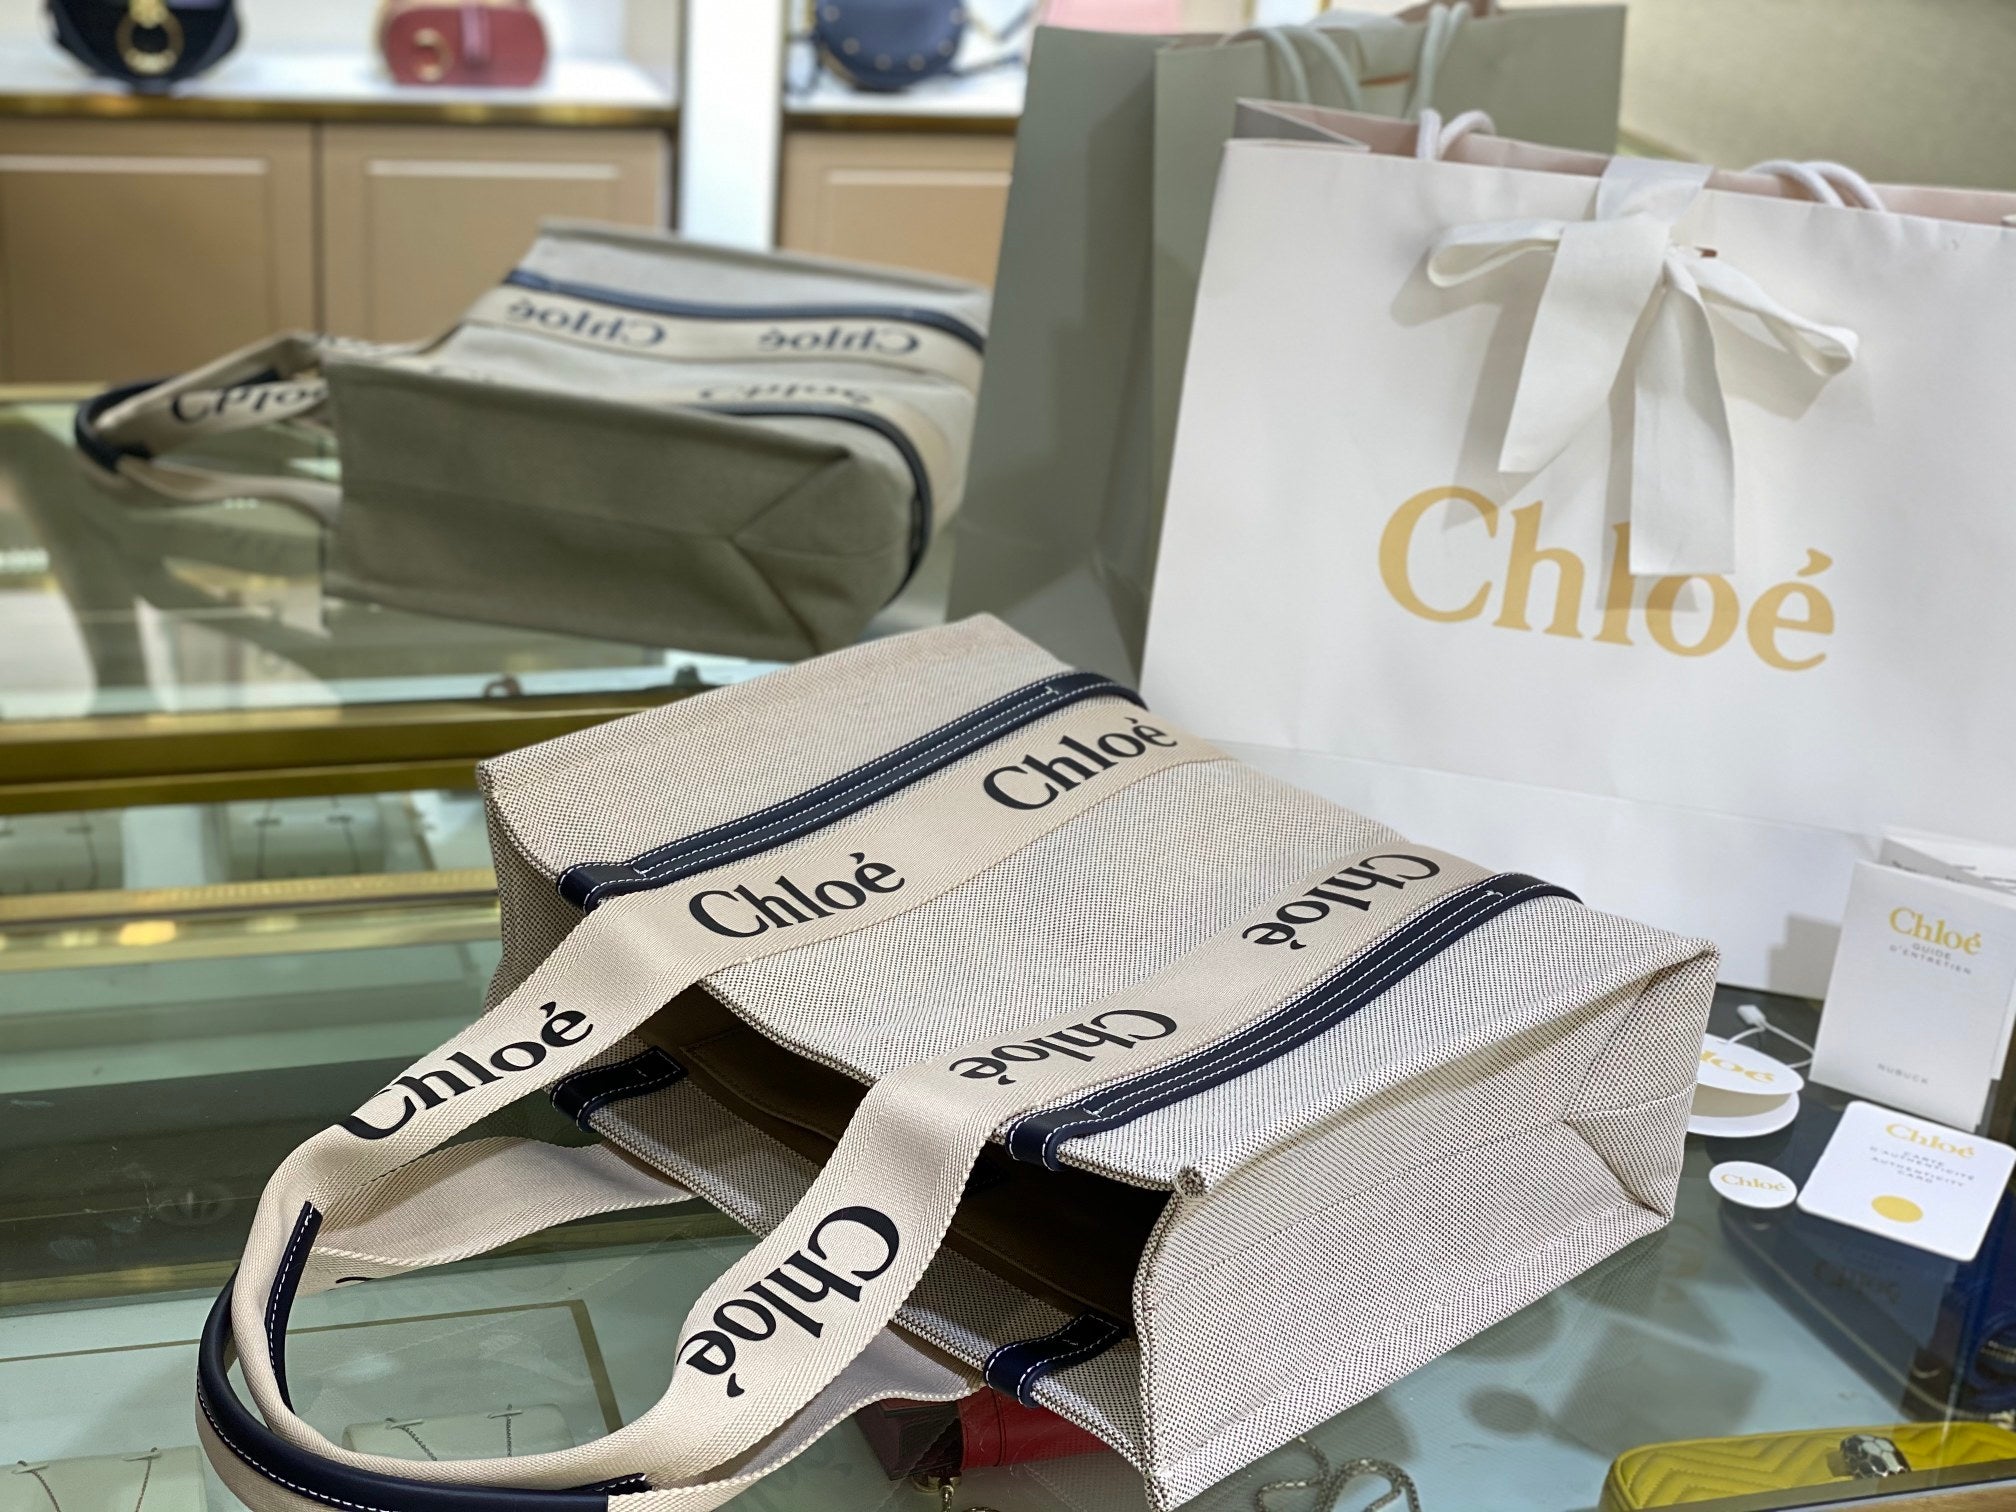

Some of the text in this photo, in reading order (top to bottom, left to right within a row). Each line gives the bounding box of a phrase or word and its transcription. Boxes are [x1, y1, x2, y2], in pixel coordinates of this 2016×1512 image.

[1378, 485, 1836, 672] Chloé
[983, 716, 1178, 812] Chloé
[688, 852, 906, 940] Chloé
[1242, 853, 1441, 950] Chloé
[1889, 906, 1983, 956] Chloé
[1912, 942, 1952, 960] GUIDE
[341, 1001, 594, 1141] Chloé
[948, 1008, 1178, 1085] Chloé
[1699, 1050, 1775, 1084] loé
[1885, 1123, 1977, 1158] Chloé
[676, 1205, 900, 1398] Chloé
